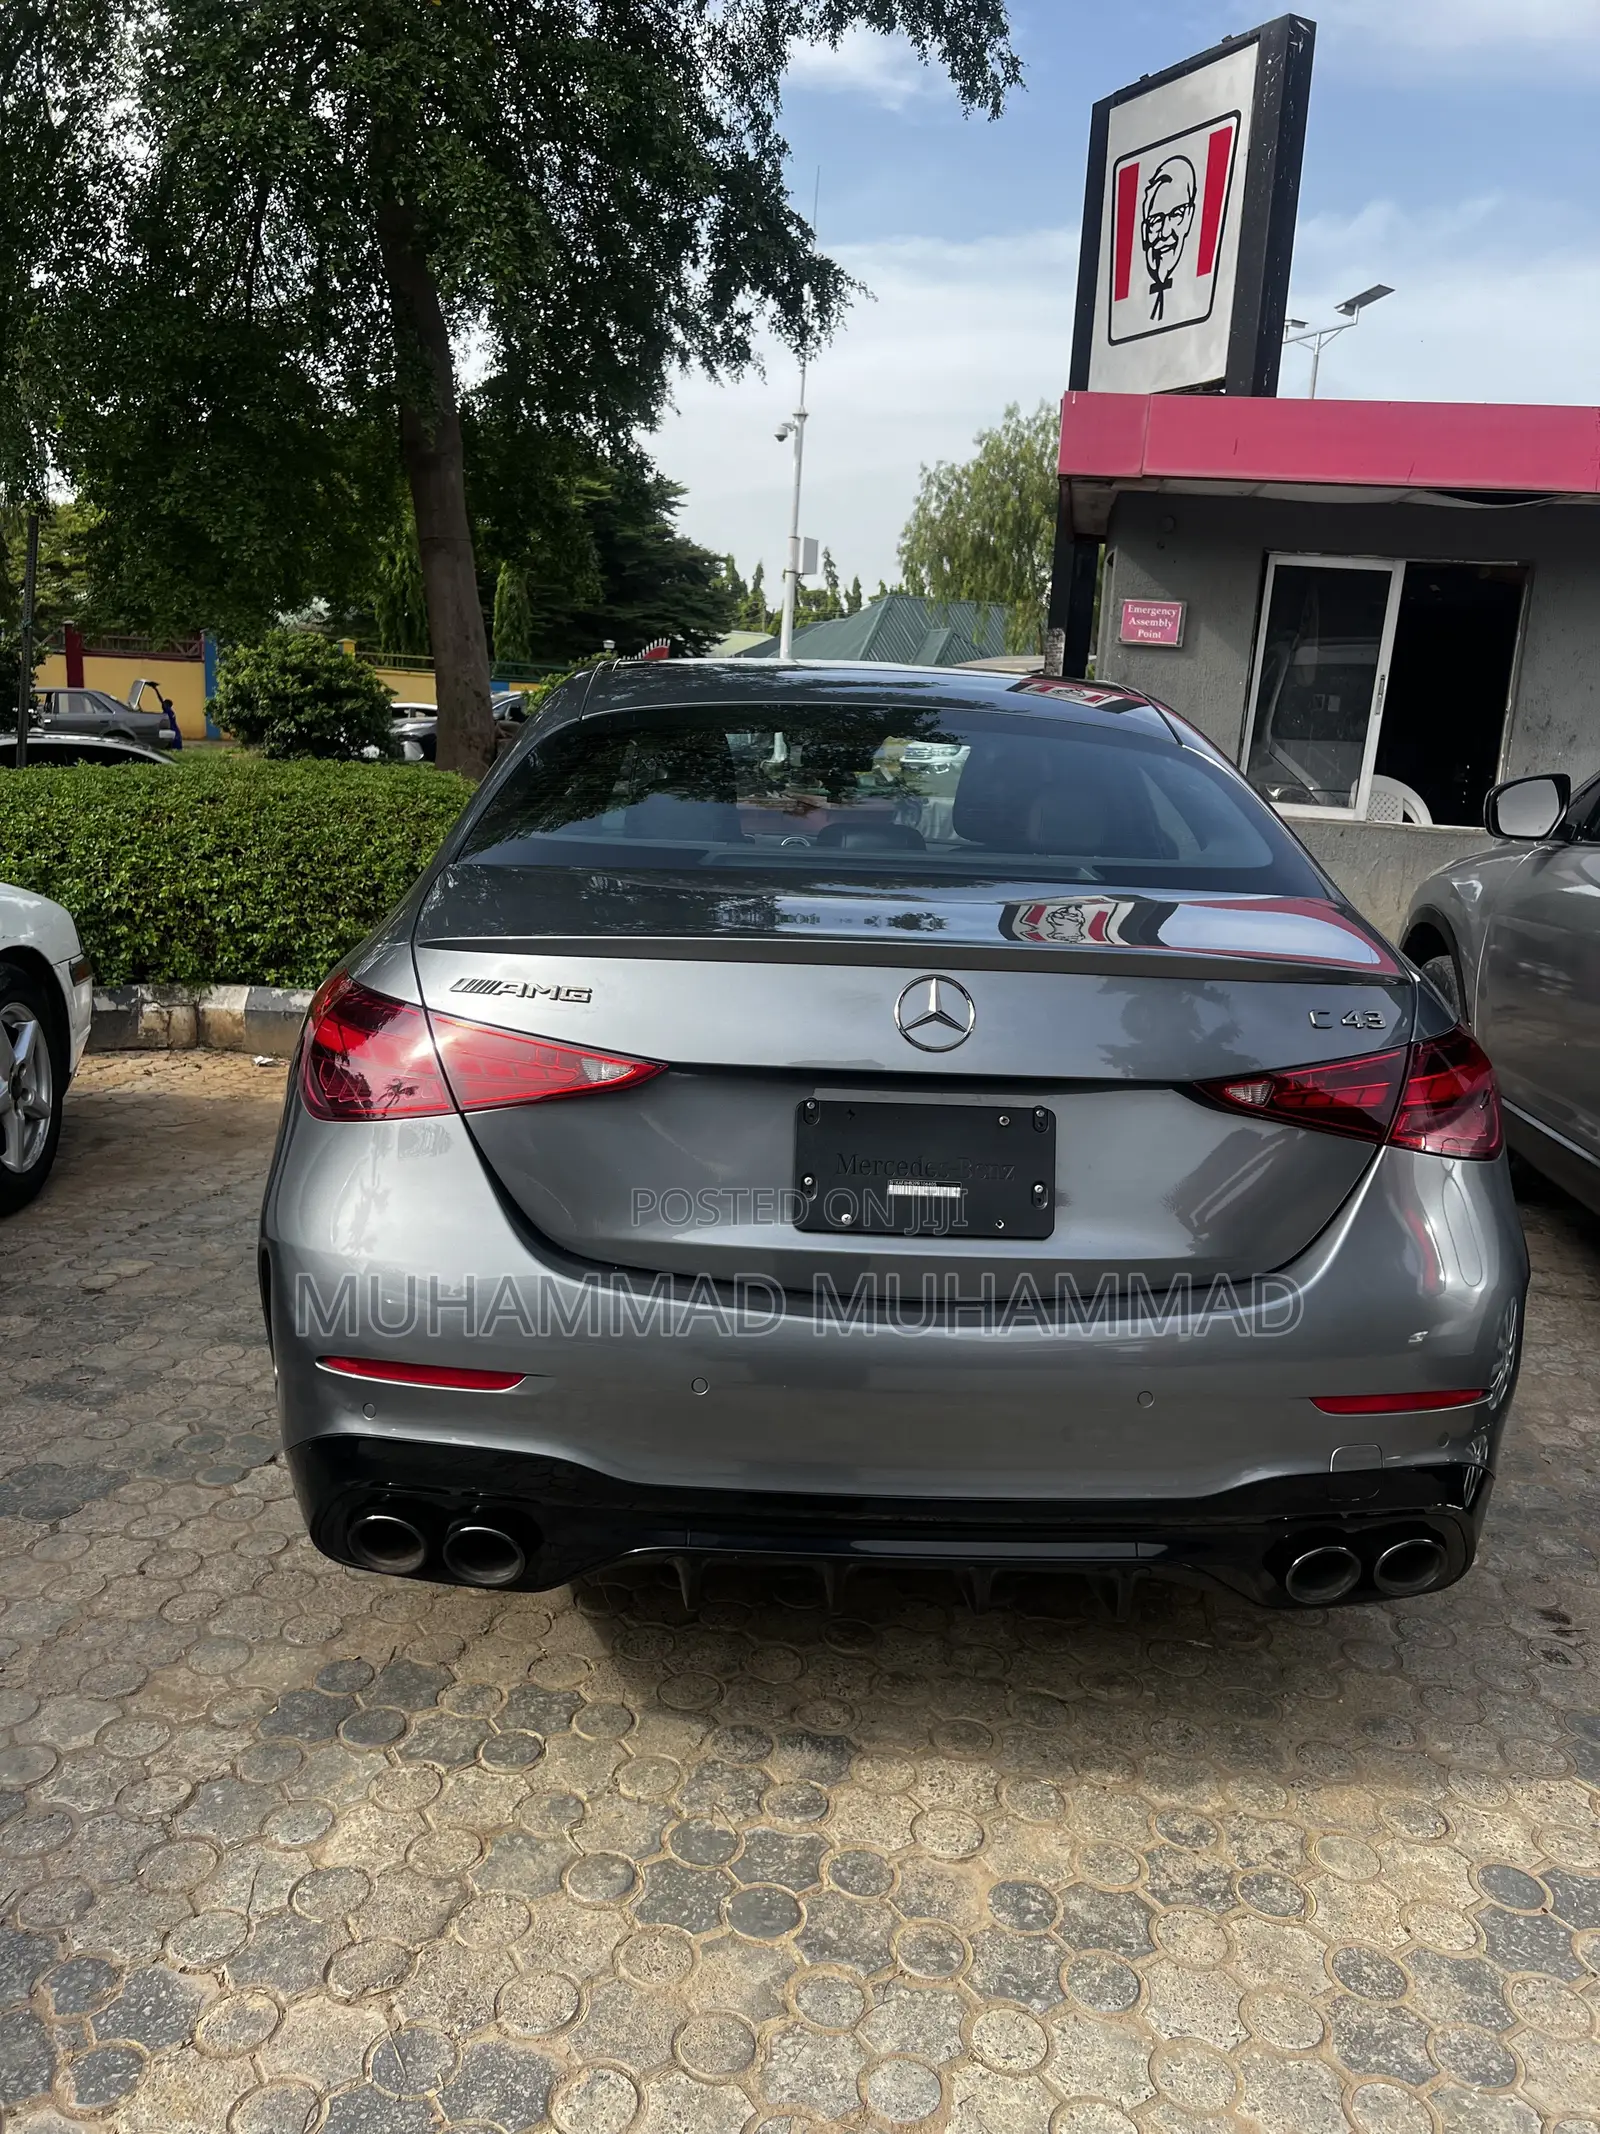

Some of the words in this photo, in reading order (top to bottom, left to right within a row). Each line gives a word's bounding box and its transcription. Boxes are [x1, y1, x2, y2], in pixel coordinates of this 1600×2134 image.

[1128, 604, 1177, 617] Emergency
[1128, 616, 1173, 630] Assembly
[1137, 628, 1161, 639] Point
[491, 980, 593, 1004] AMG
[1308, 1009, 1334, 1030] C
[1340, 1009, 1387, 1030] 43
[835, 1152, 1017, 1182] Mercedes-Benz
